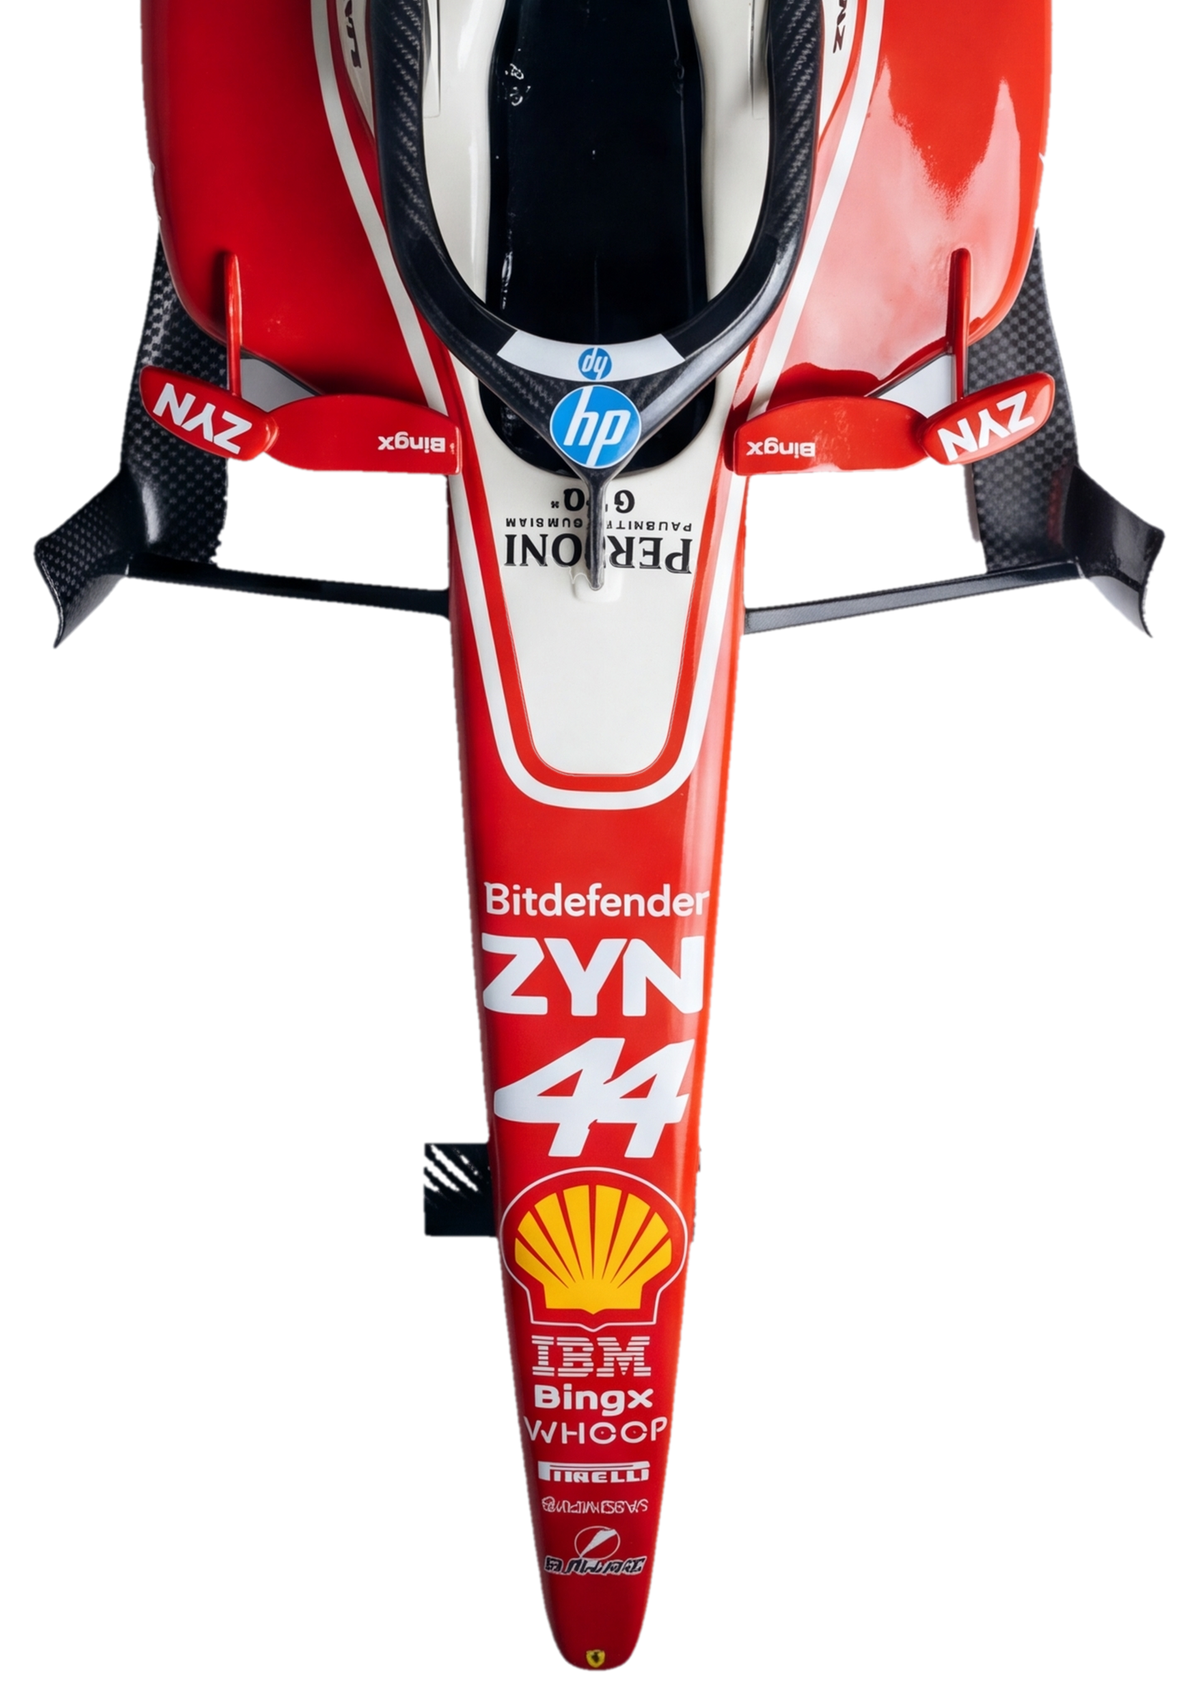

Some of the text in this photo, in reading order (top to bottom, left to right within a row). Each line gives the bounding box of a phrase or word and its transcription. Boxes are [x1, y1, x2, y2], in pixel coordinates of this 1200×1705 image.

[152, 382, 253, 455] ZYN
[563, 385, 632, 468] hp
[937, 390, 1036, 462] ZYN
[504, 533, 693, 574] PERONI
[483, 882, 710, 917] Bitdefender
[481, 932, 705, 1017] ZYN
[493, 1037, 696, 1158] 44
[531, 1335, 652, 1377] IBM
[534, 1383, 654, 1416] Bingx
[537, 1460, 651, 1483] PIRELLI
